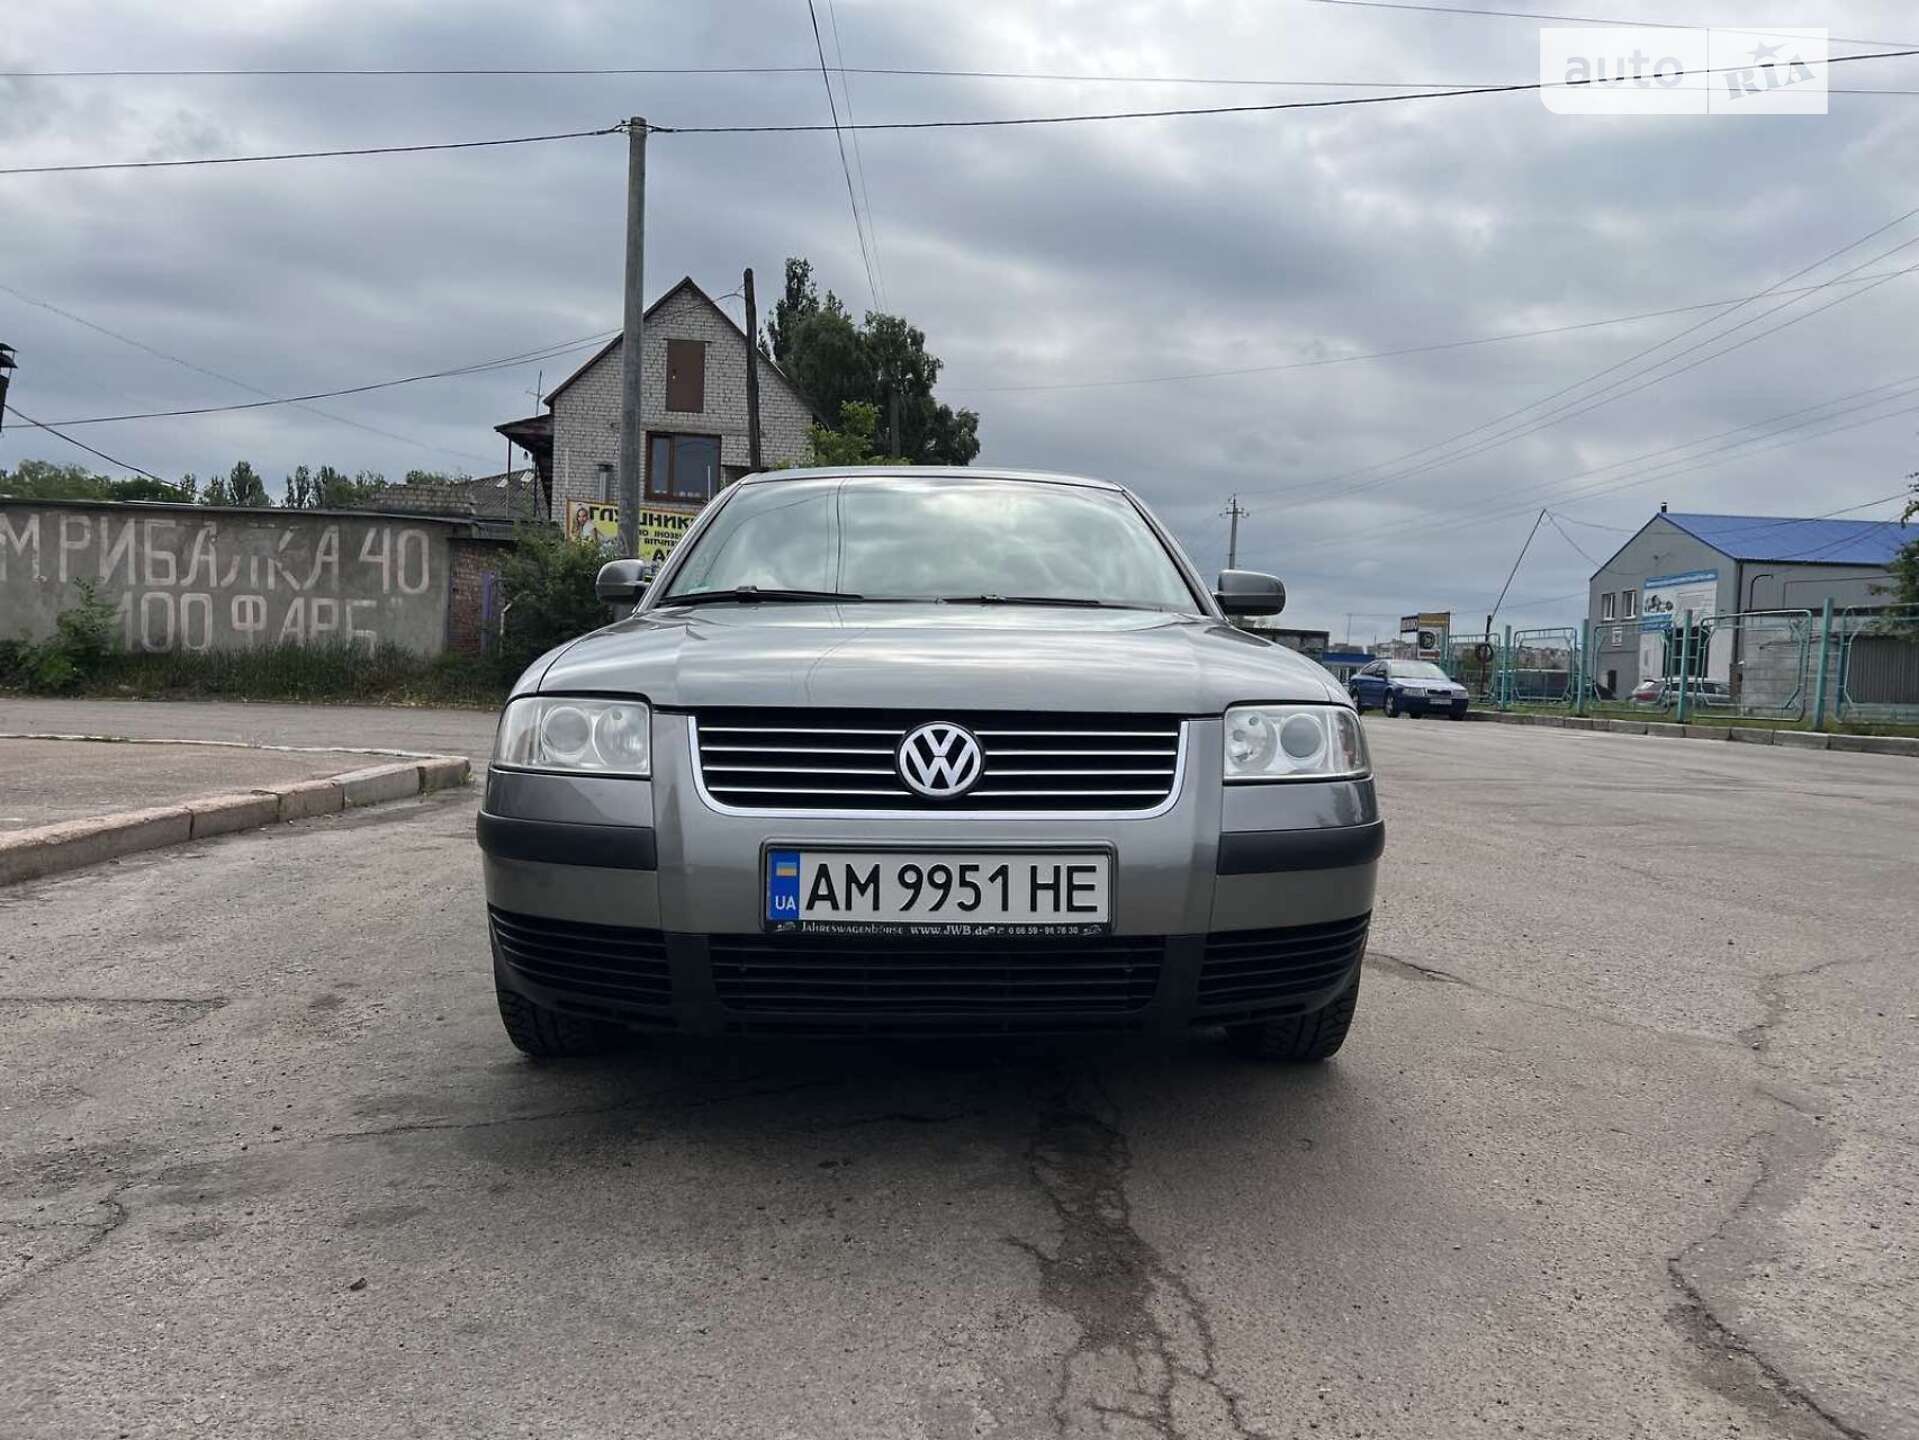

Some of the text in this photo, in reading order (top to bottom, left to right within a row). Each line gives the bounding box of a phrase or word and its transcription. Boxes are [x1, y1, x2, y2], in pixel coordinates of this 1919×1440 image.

[358, 527, 430, 595] 40
[775, 896, 796, 911] UA
[805, 863, 1098, 913] AM 9951 HE
